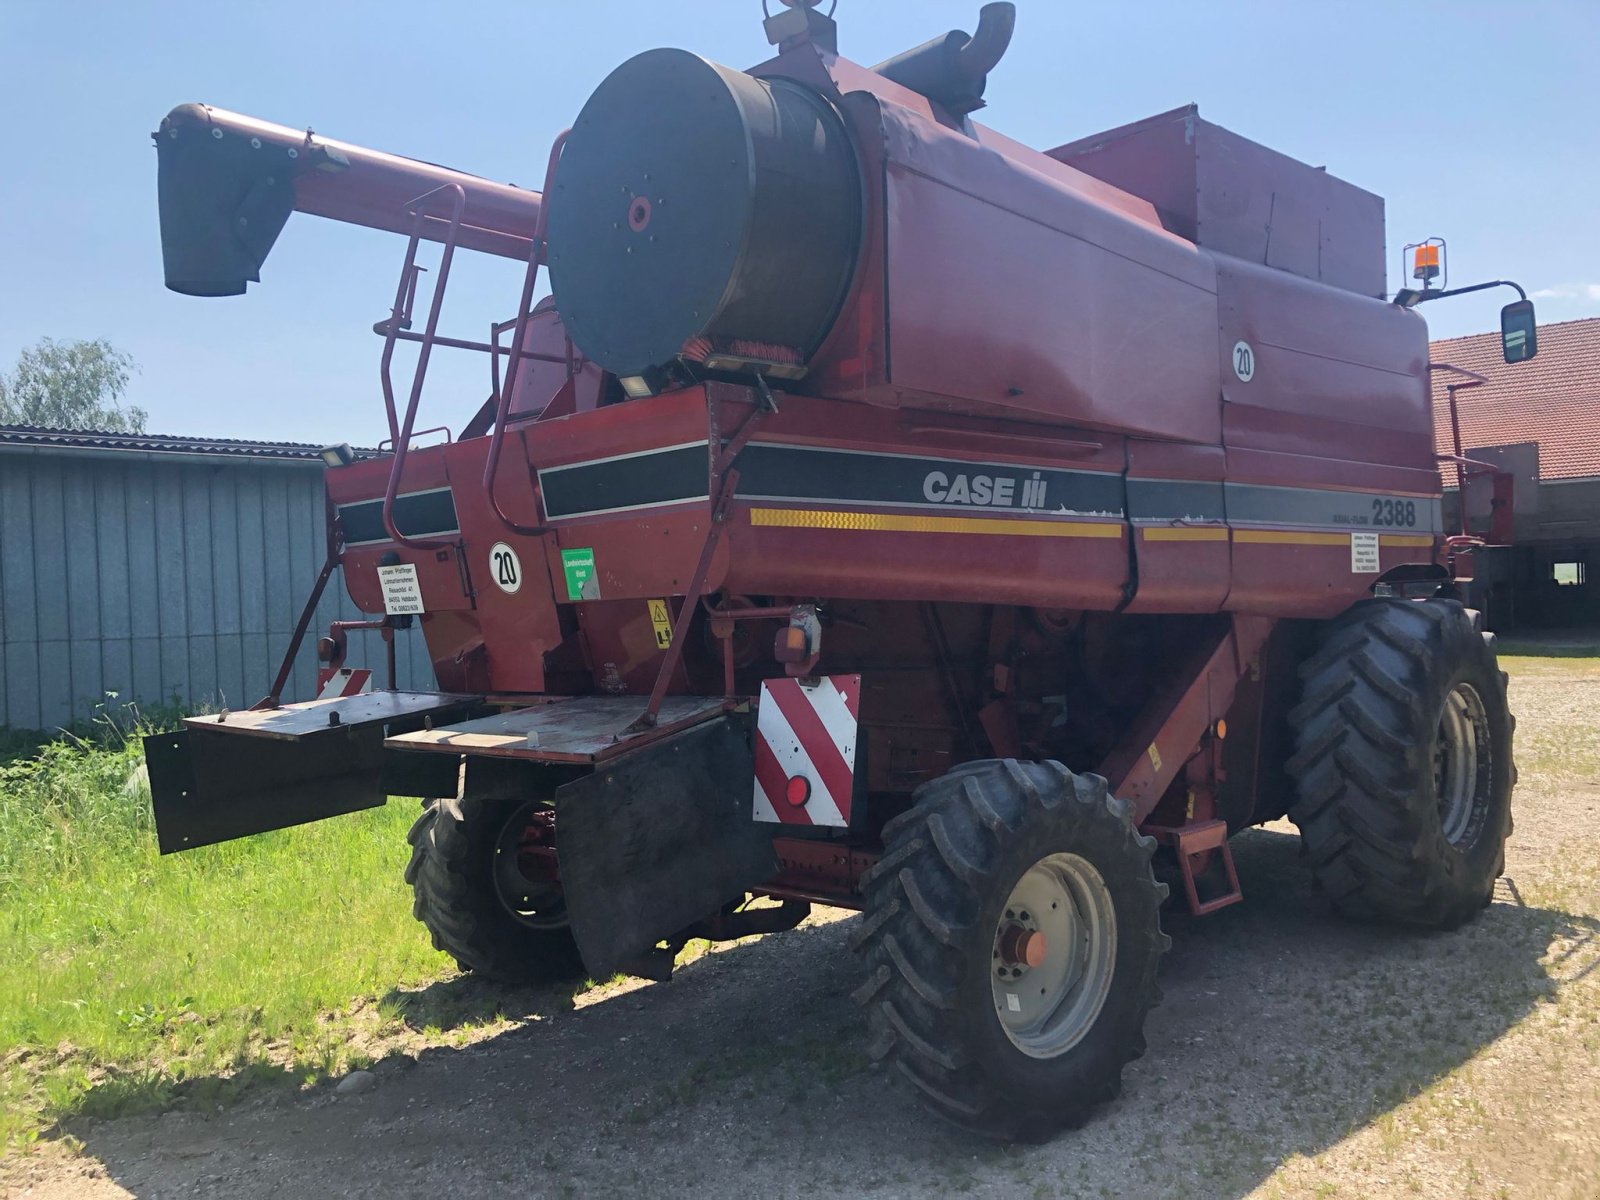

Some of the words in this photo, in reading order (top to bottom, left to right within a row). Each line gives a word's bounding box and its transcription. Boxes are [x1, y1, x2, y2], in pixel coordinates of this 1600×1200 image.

[1236, 347, 1251, 376] 20
[922, 470, 1016, 507] CASE
[1372, 498, 1417, 527] 2388
[494, 551, 517, 585] 20
